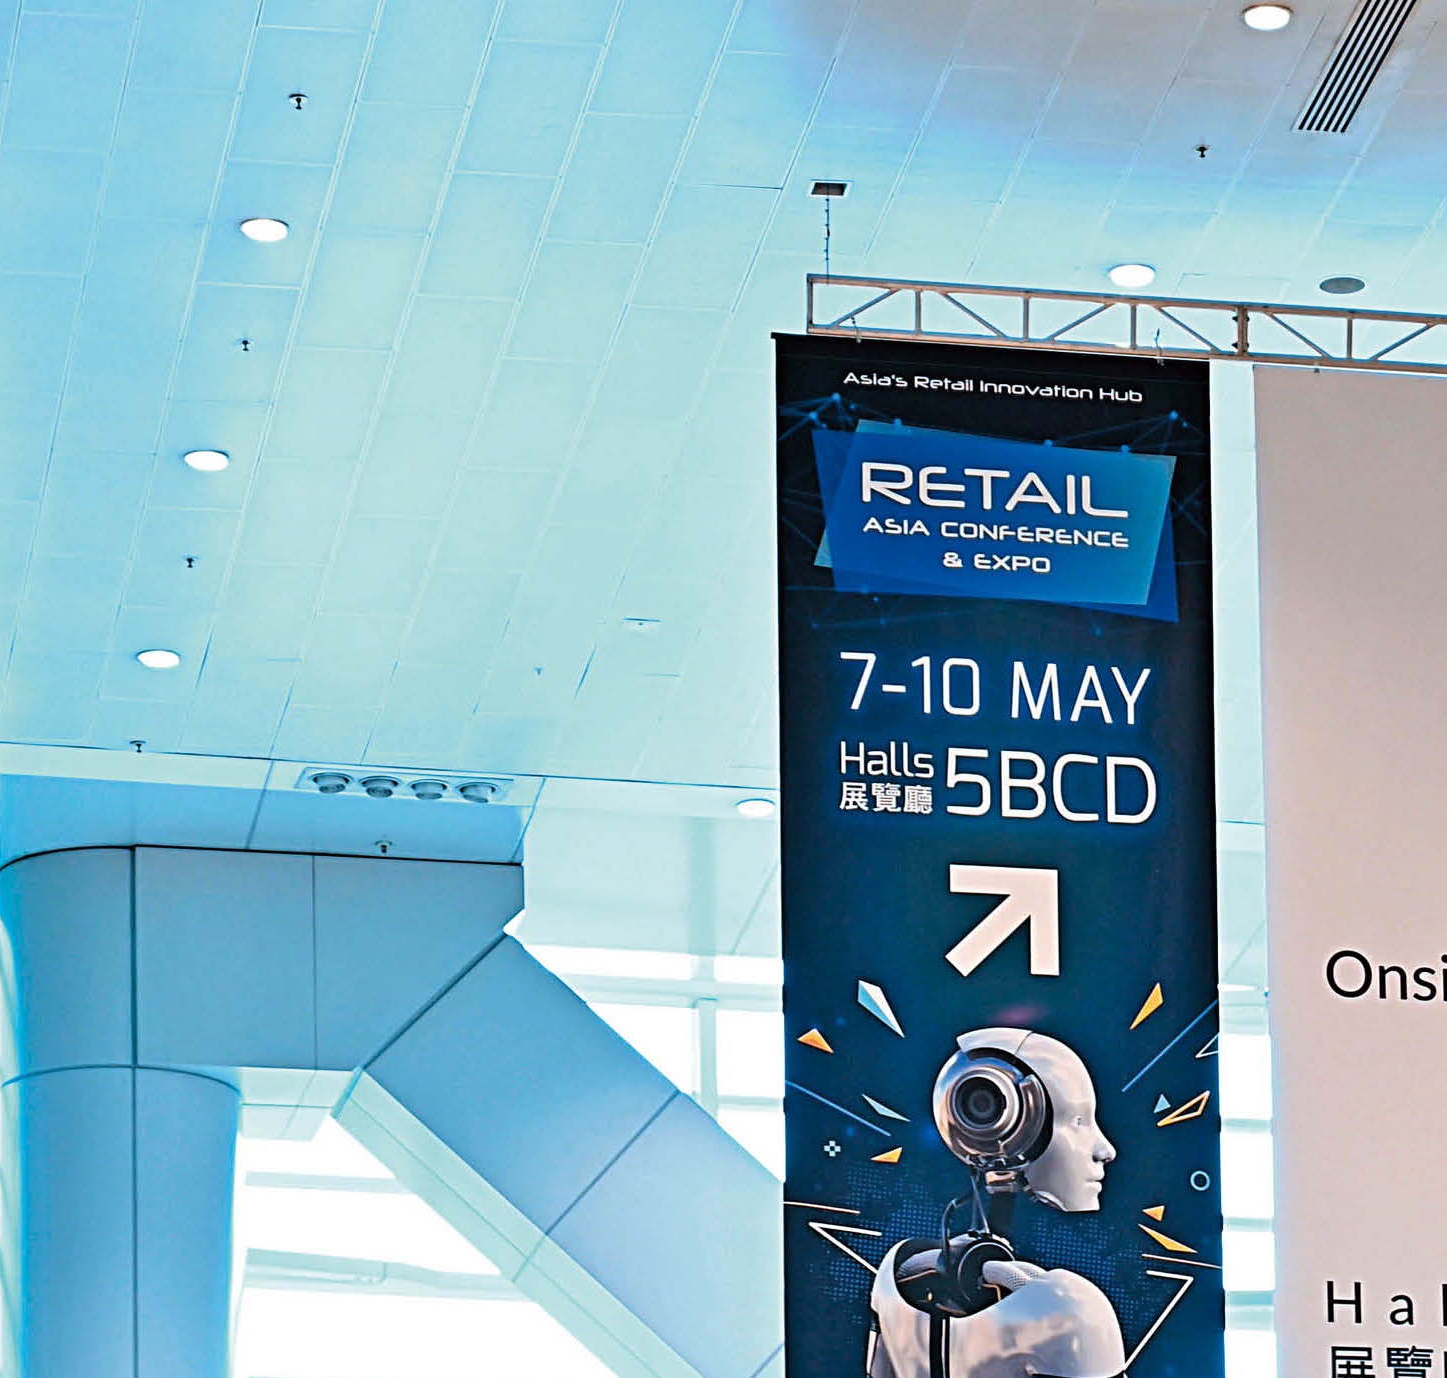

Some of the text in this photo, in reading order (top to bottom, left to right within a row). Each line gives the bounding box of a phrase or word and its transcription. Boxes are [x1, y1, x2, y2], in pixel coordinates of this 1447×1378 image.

[843, 372, 1143, 402] Asia's Retail Innovation Hub
[862, 462, 1129, 518] RETAIL
[863, 517, 1129, 548] ASIA CONFERENCE
[943, 552, 1051, 573] & EXPO
[840, 652, 1151, 725] 7-10 MAY
[839, 781, 934, 815] 展覽廳
[840, 741, 1157, 824] Halls 5BCD
